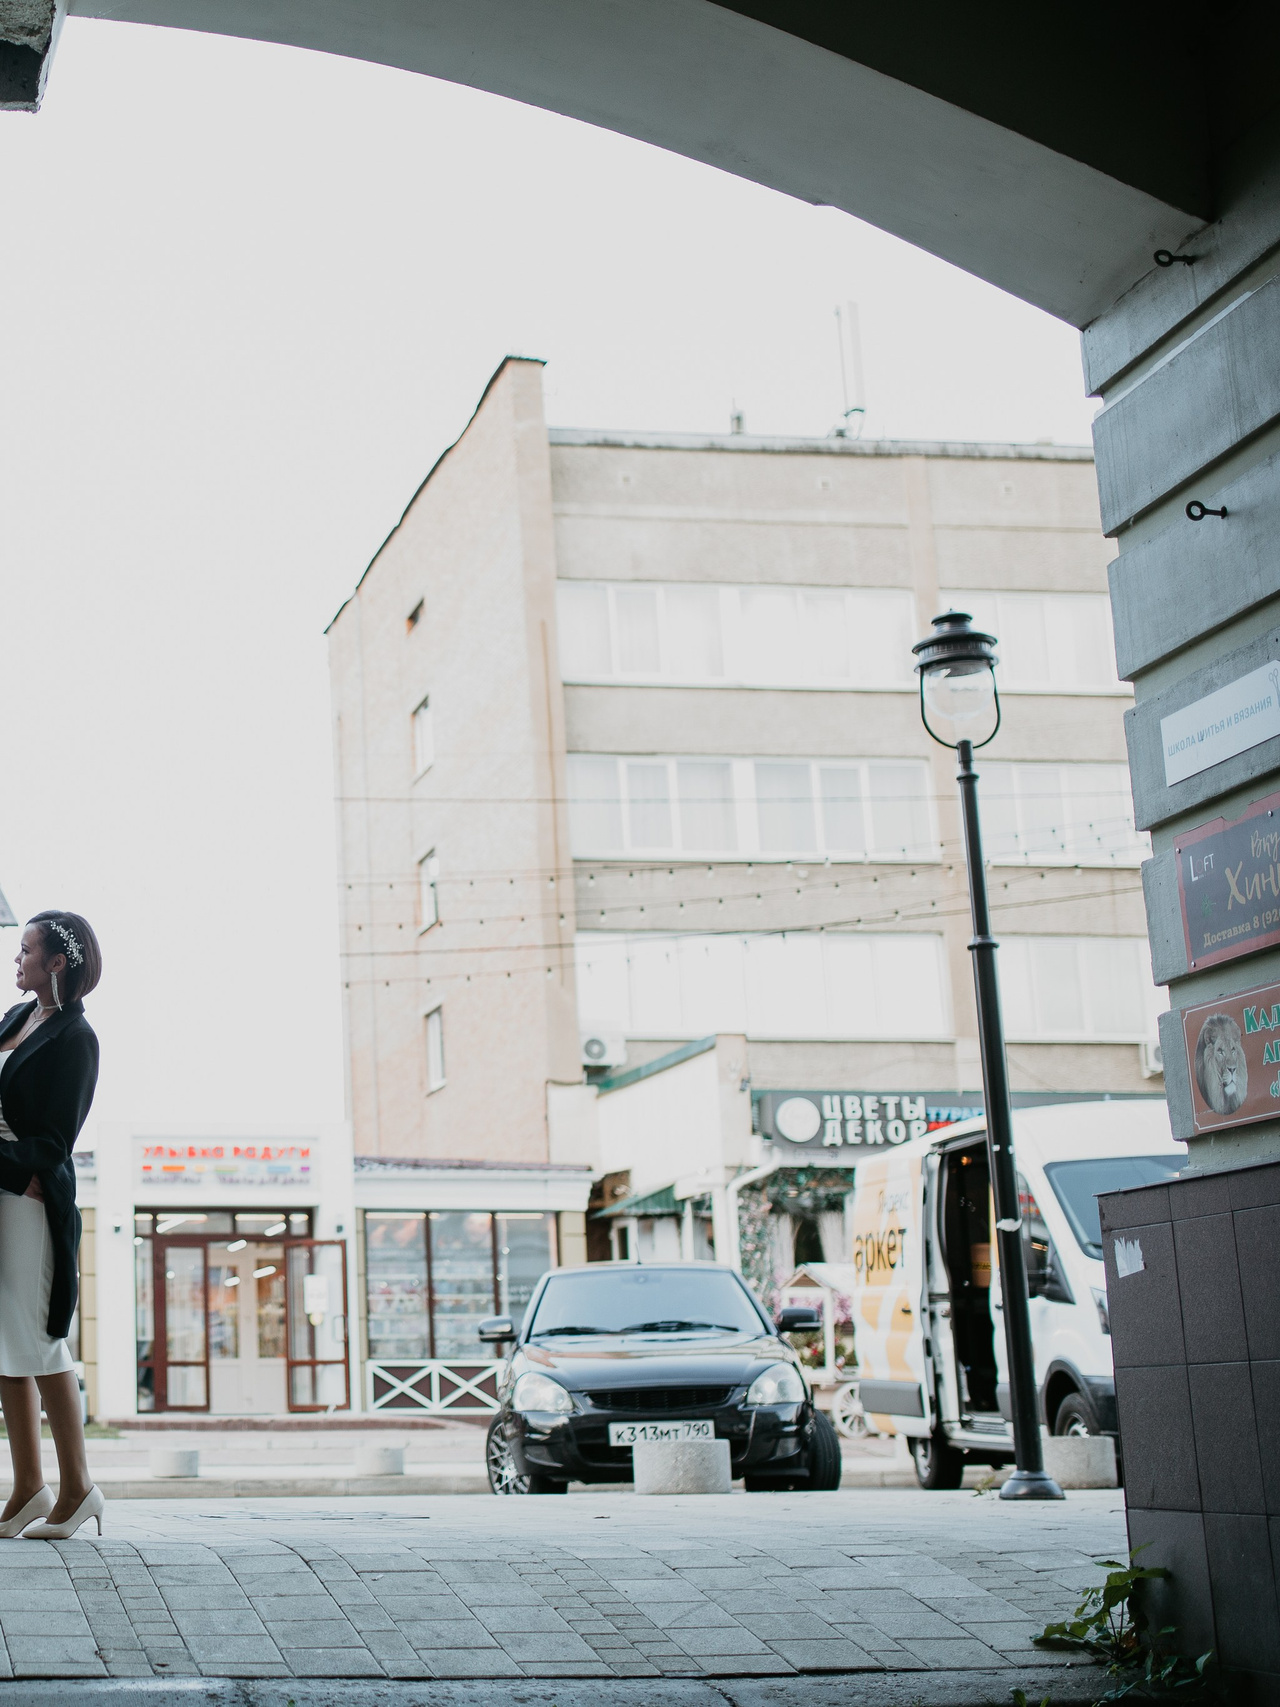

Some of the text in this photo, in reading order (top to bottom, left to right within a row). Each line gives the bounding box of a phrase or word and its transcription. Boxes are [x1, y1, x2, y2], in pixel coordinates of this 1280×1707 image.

[1167, 695, 1273, 757] ШКОЛА ШИТЬЯ И ВЯЗАНИЯ
[1224, 860, 1280, 911] Хин
[1202, 921, 1251, 949] Доставка
[1253, 915, 1260, 929] 8
[821, 1094, 927, 1121] ЦВЕТЫ
[822, 1119, 928, 1147] ДЕКОР
[683, 1423, 710, 1437] 790
